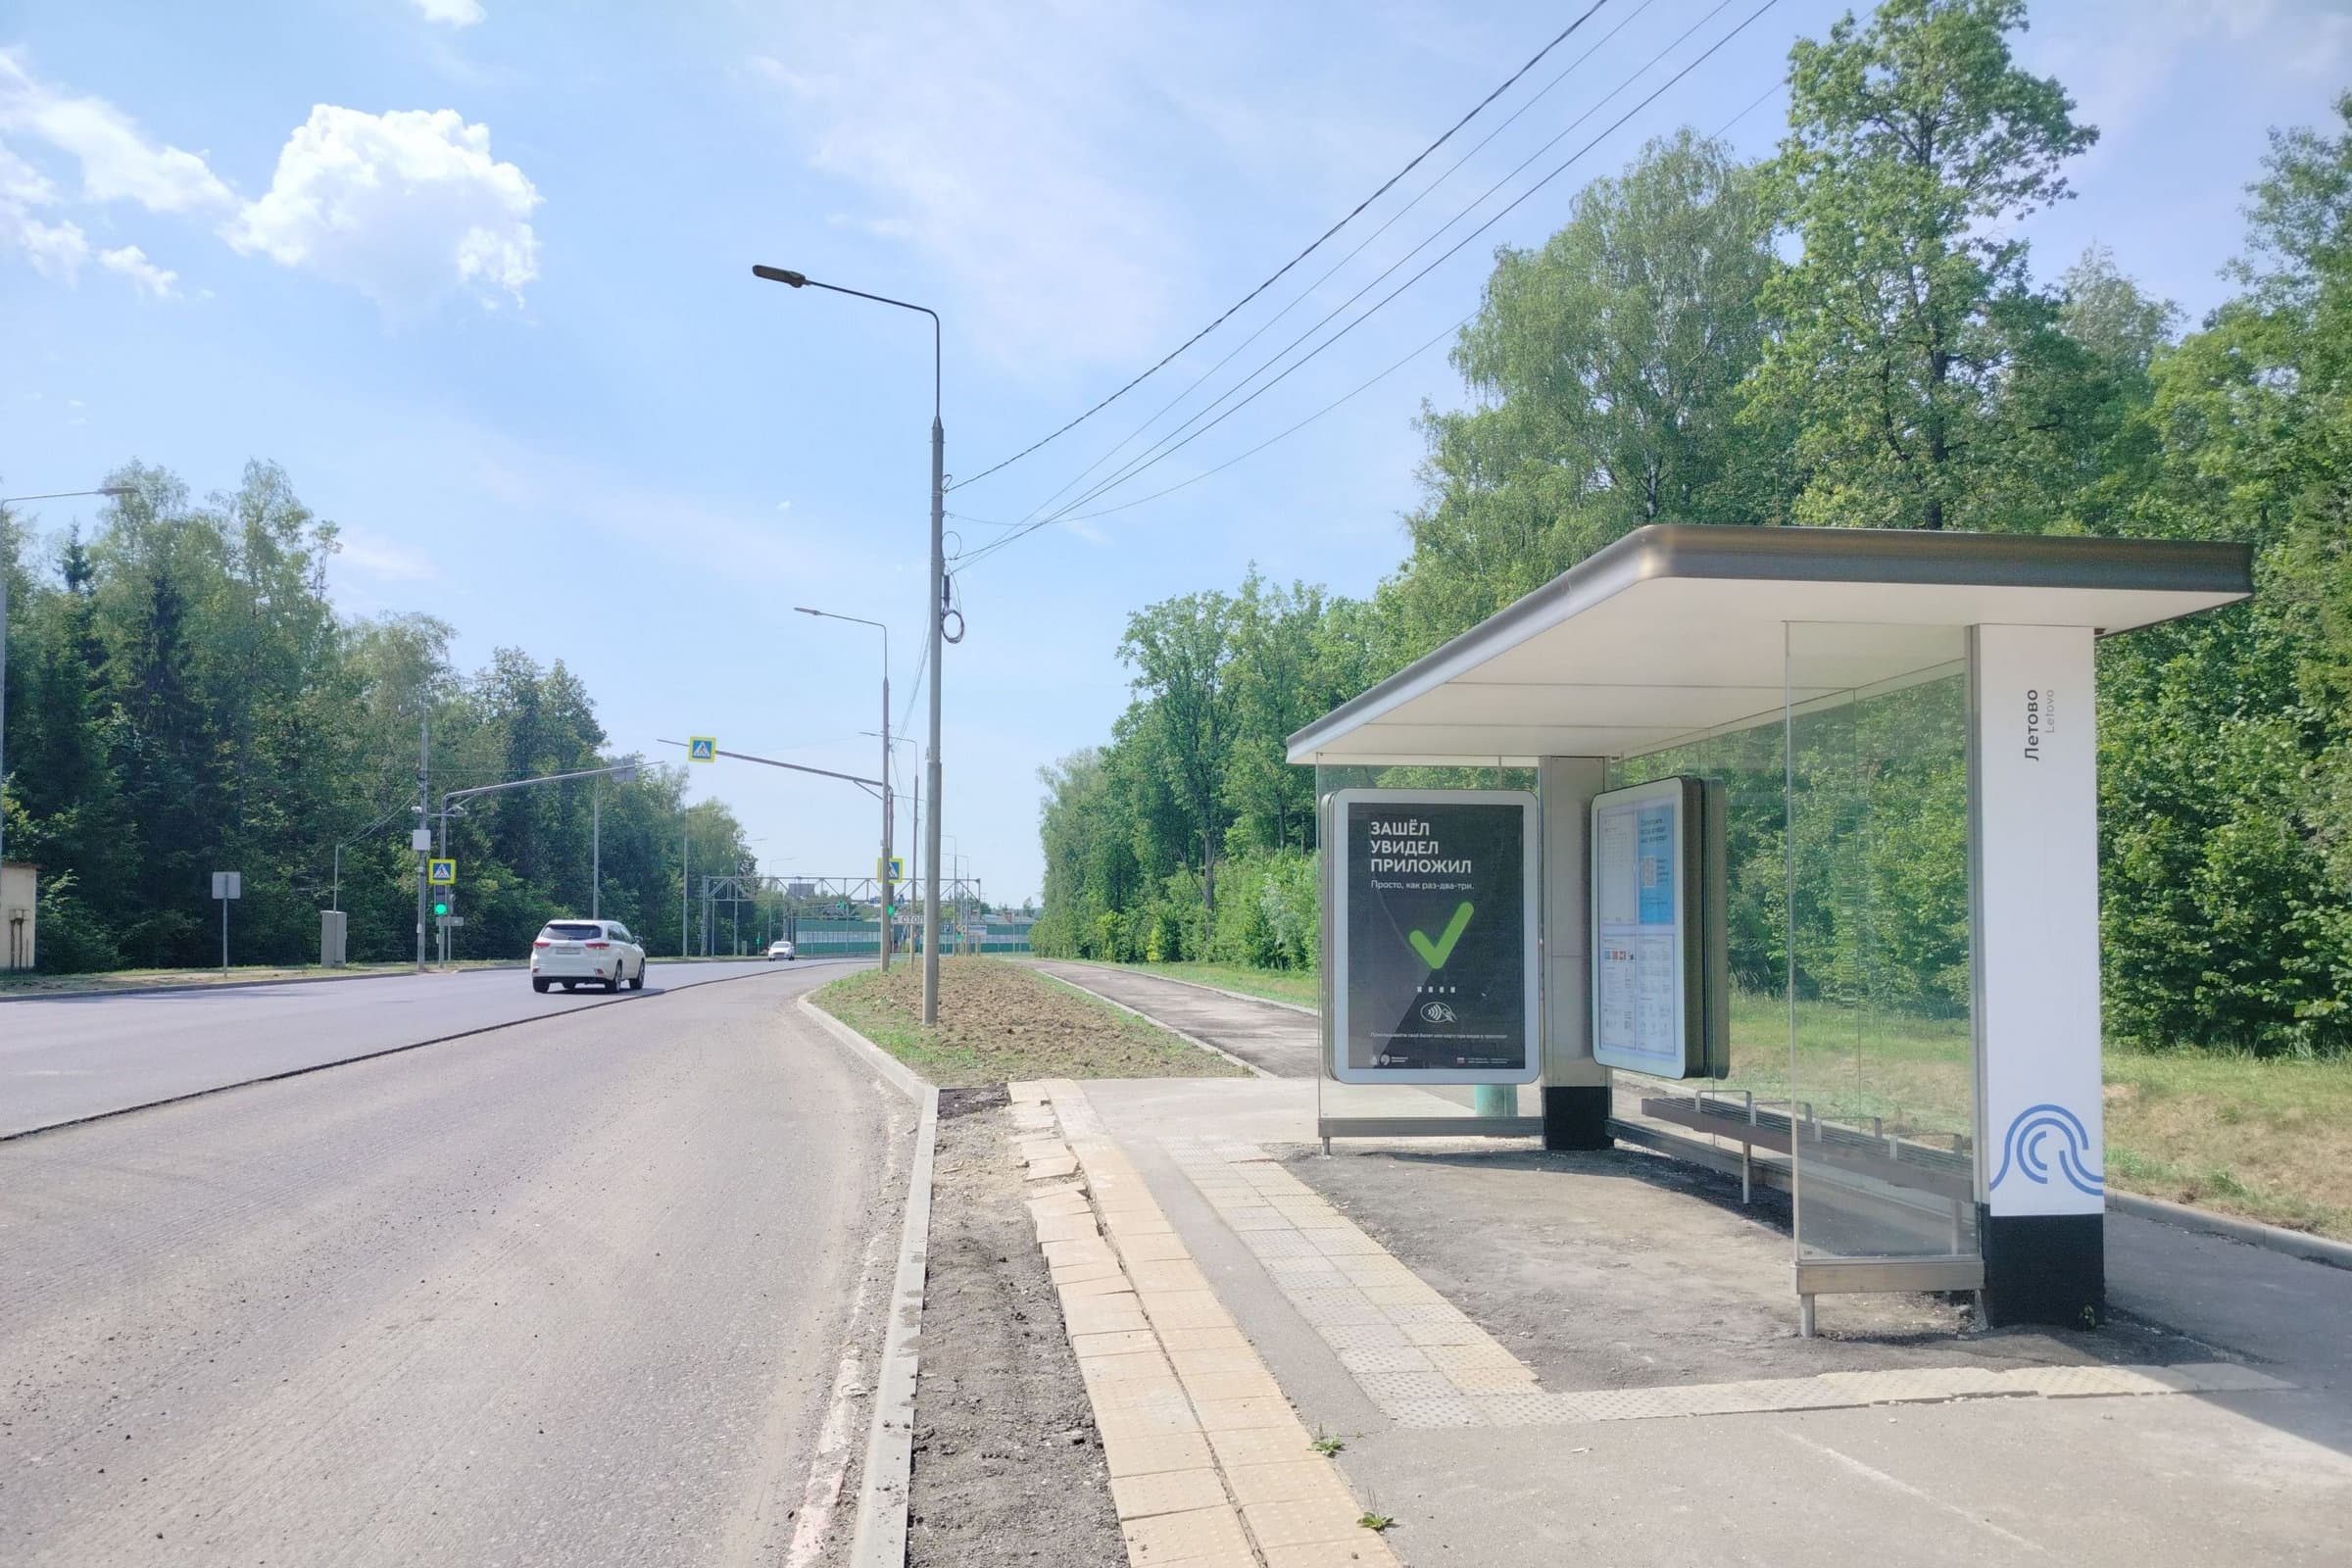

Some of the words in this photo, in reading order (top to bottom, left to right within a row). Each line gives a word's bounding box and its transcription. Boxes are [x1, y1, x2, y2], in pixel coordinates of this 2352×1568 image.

[2045, 689, 2055, 733] Letovo
[2025, 689, 2039, 761] Летово
[1371, 819, 1430, 836] ЗАШЁЛ
[1371, 841, 1439, 857] УВИДЕЛ
[1371, 859, 1472, 873] ПРИЛОЖИЛ
[1371, 880, 1404, 890] Просто,
